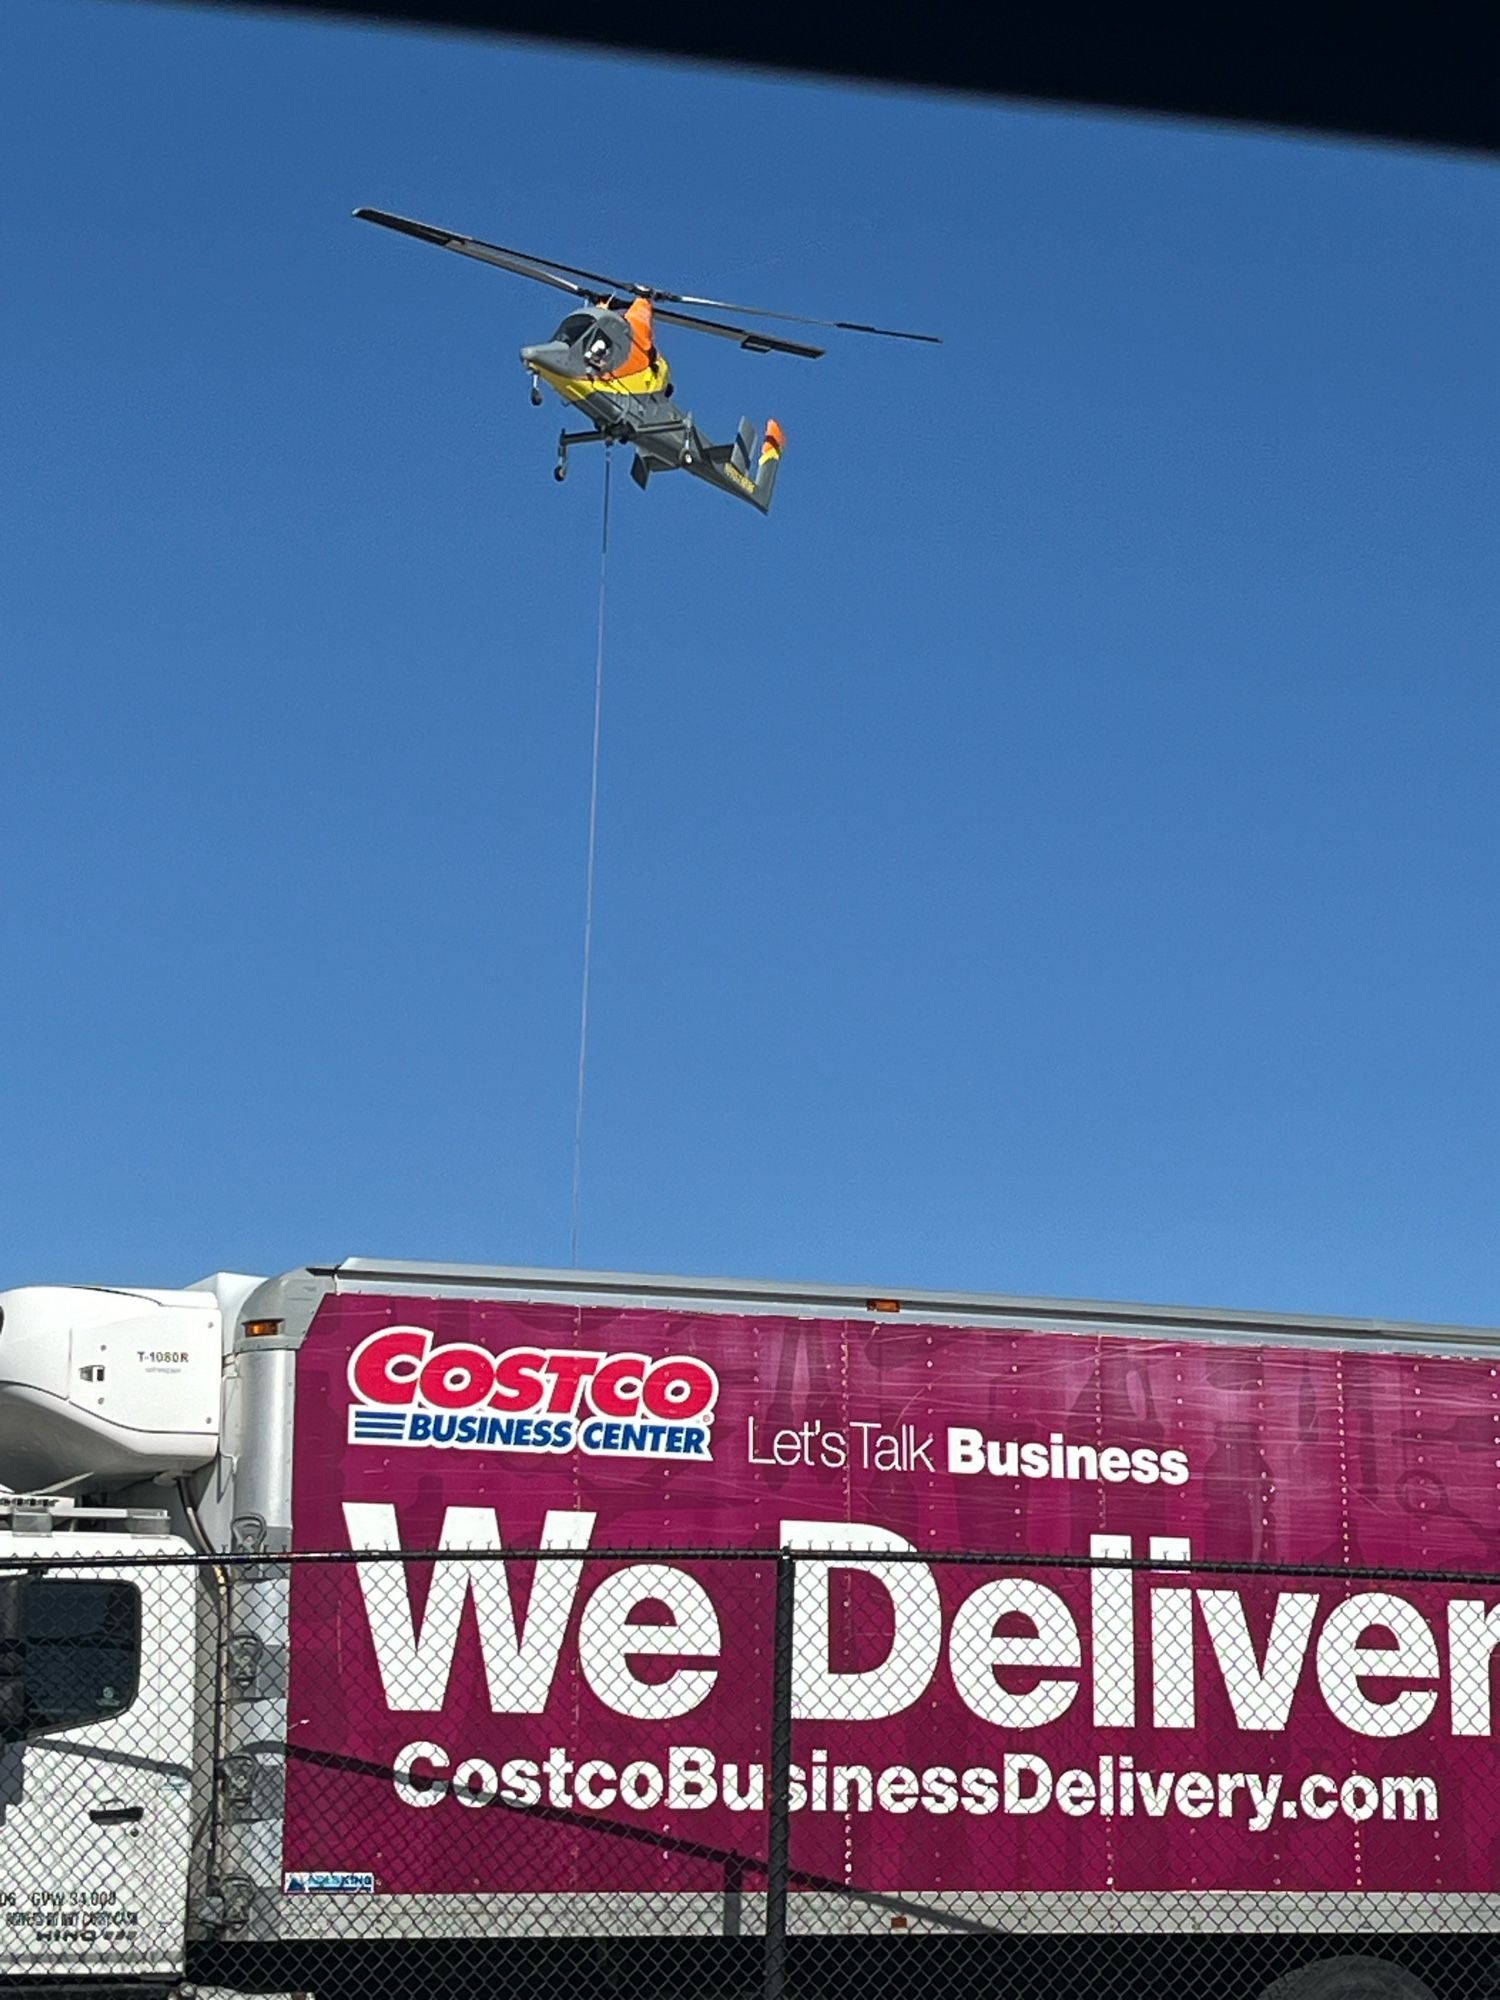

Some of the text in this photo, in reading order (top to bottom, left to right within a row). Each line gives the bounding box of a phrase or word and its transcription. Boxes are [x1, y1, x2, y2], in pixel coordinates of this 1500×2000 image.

[136, 1350, 189, 1363] T-1080R
[352, 1330, 714, 1420] COSTCO
[408, 1414, 706, 1455] BUSINESS CENTER
[747, 1416, 1190, 1486] Let's Talk Business
[342, 1502, 722, 1720] We
[392, 1741, 1439, 1833] CostcoBusinessDelivery.com
